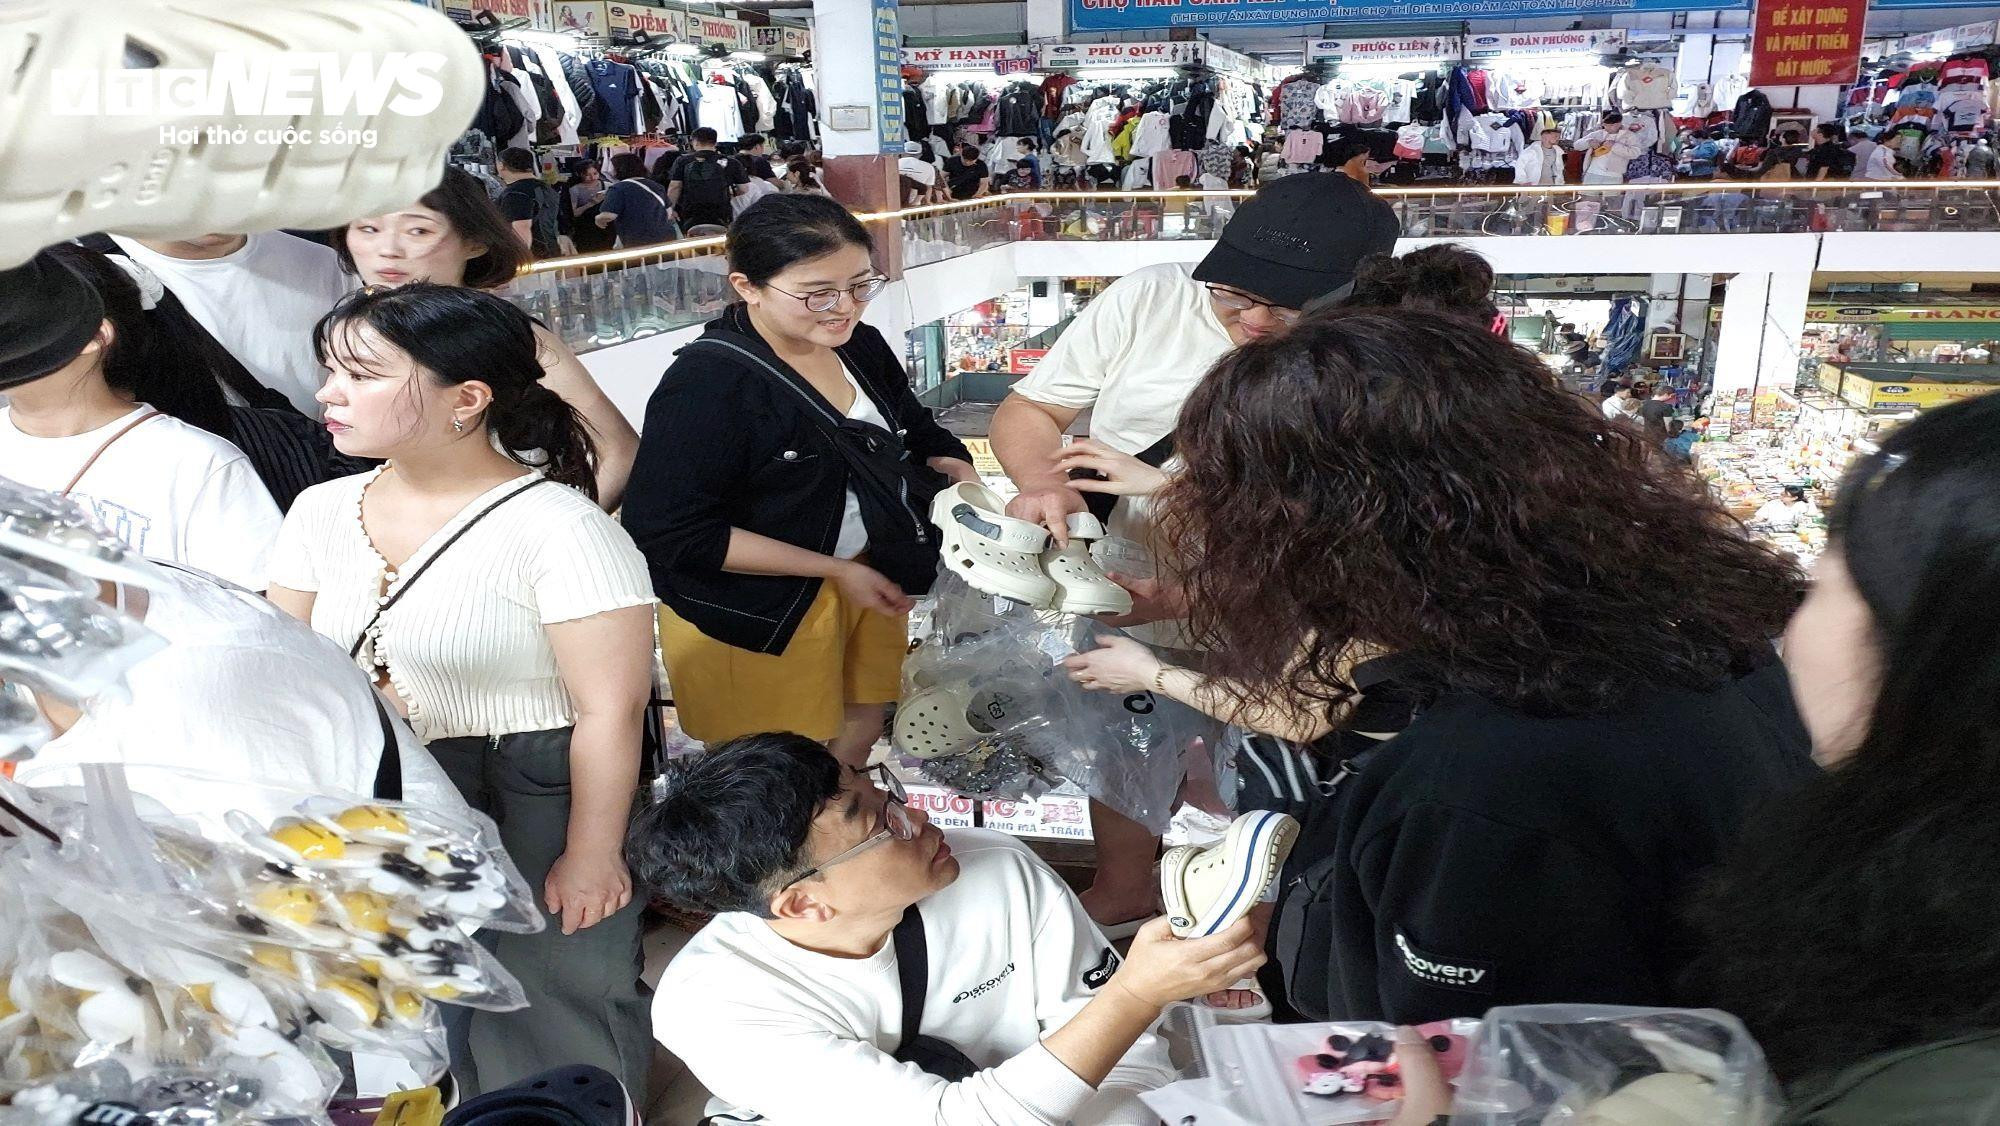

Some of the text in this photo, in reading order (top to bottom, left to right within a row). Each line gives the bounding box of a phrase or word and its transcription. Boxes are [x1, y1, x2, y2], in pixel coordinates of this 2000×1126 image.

[1791, 6, 1814, 25] XÂY
[1816, 6, 1848, 27] DỰNG
[1087, 45, 1124, 56] PHÚ
[1129, 44, 1166, 56] QUÝ
[998, 60, 1031, 76] 159
